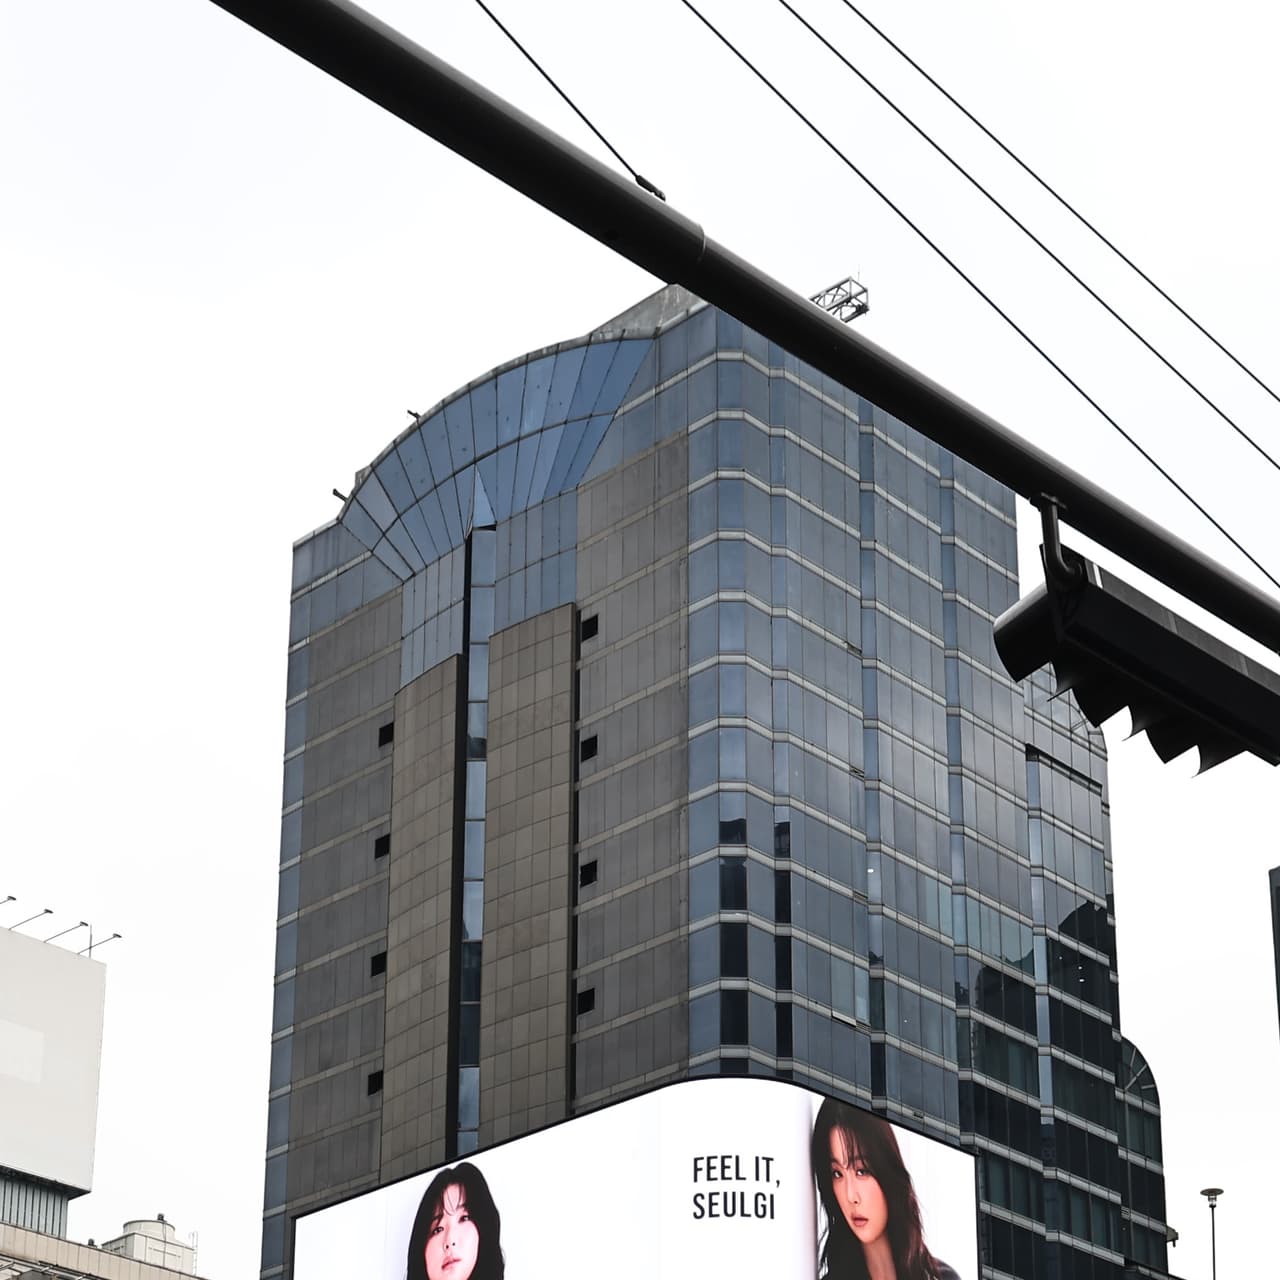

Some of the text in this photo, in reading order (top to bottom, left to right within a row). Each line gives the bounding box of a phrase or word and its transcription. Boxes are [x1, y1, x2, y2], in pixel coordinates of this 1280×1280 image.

[693, 1154, 780, 1188] FEEL IT,
[693, 1191, 775, 1220] SEULGI
